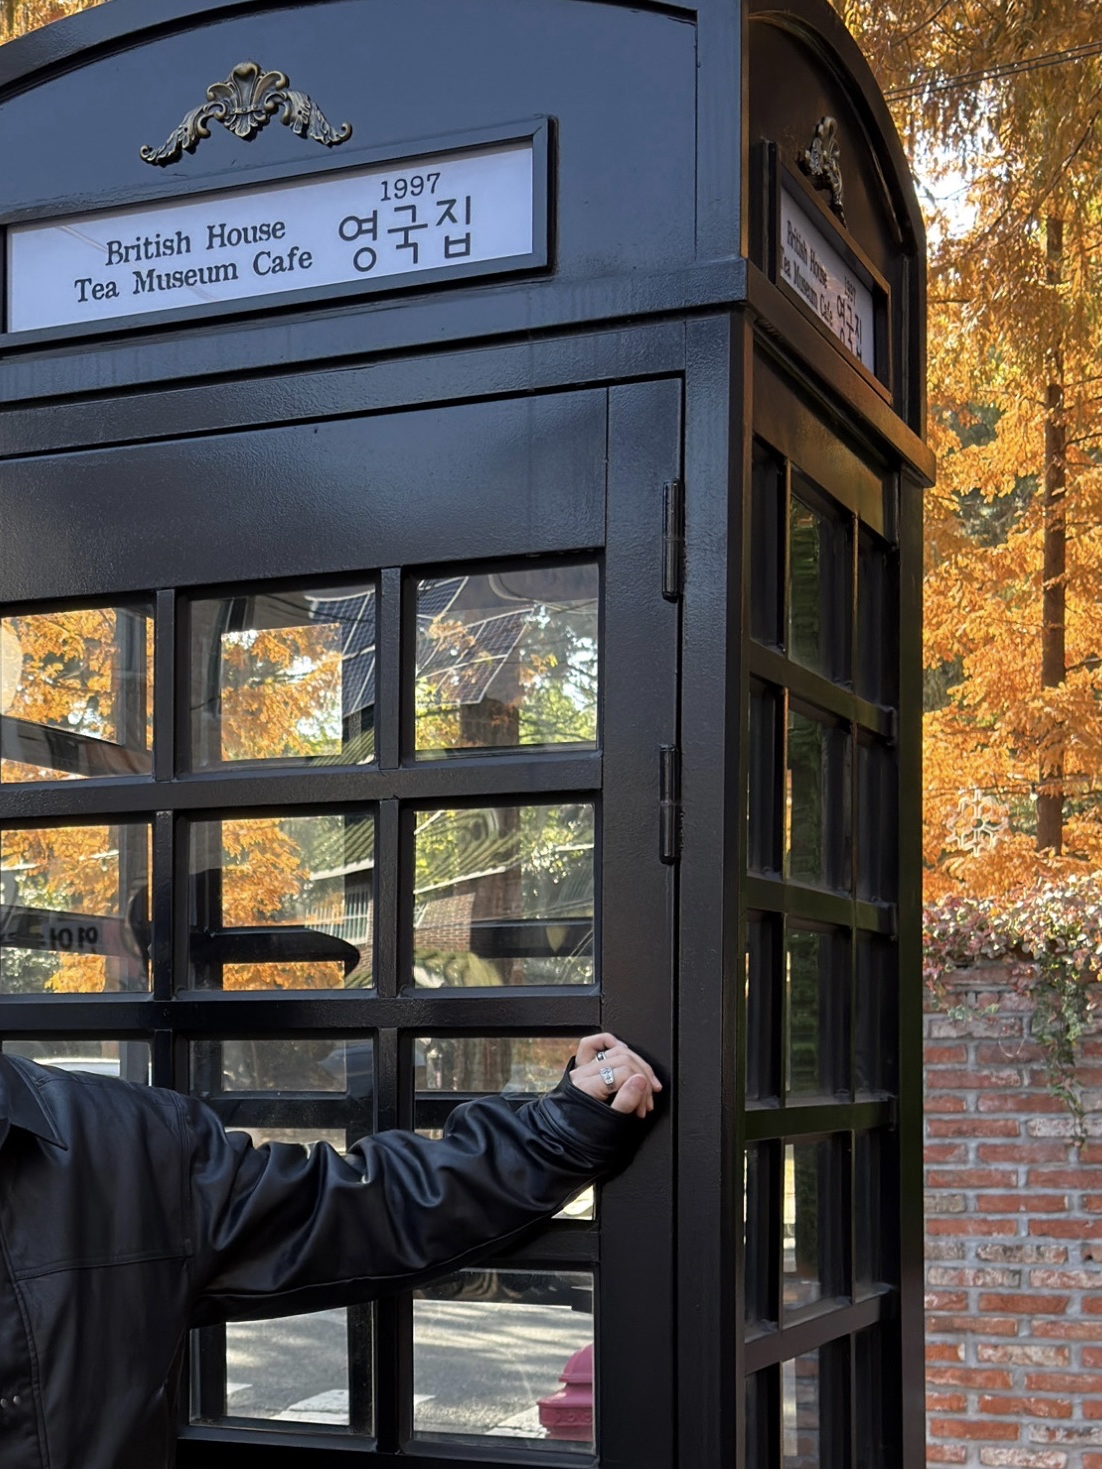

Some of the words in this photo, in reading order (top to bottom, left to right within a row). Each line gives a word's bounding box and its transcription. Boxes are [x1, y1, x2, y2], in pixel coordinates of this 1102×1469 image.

[380, 172, 442, 202] 1997
[105, 230, 191, 266] British
[207, 218, 286, 251] House
[339, 195, 471, 273] 영국집
[787, 220, 808, 266] British
[810, 248, 828, 289] House
[74, 277, 119, 303] Tea
[133, 261, 238, 295] Museum
[253, 247, 313, 277] Cafe
[783, 256, 791, 279] ea
